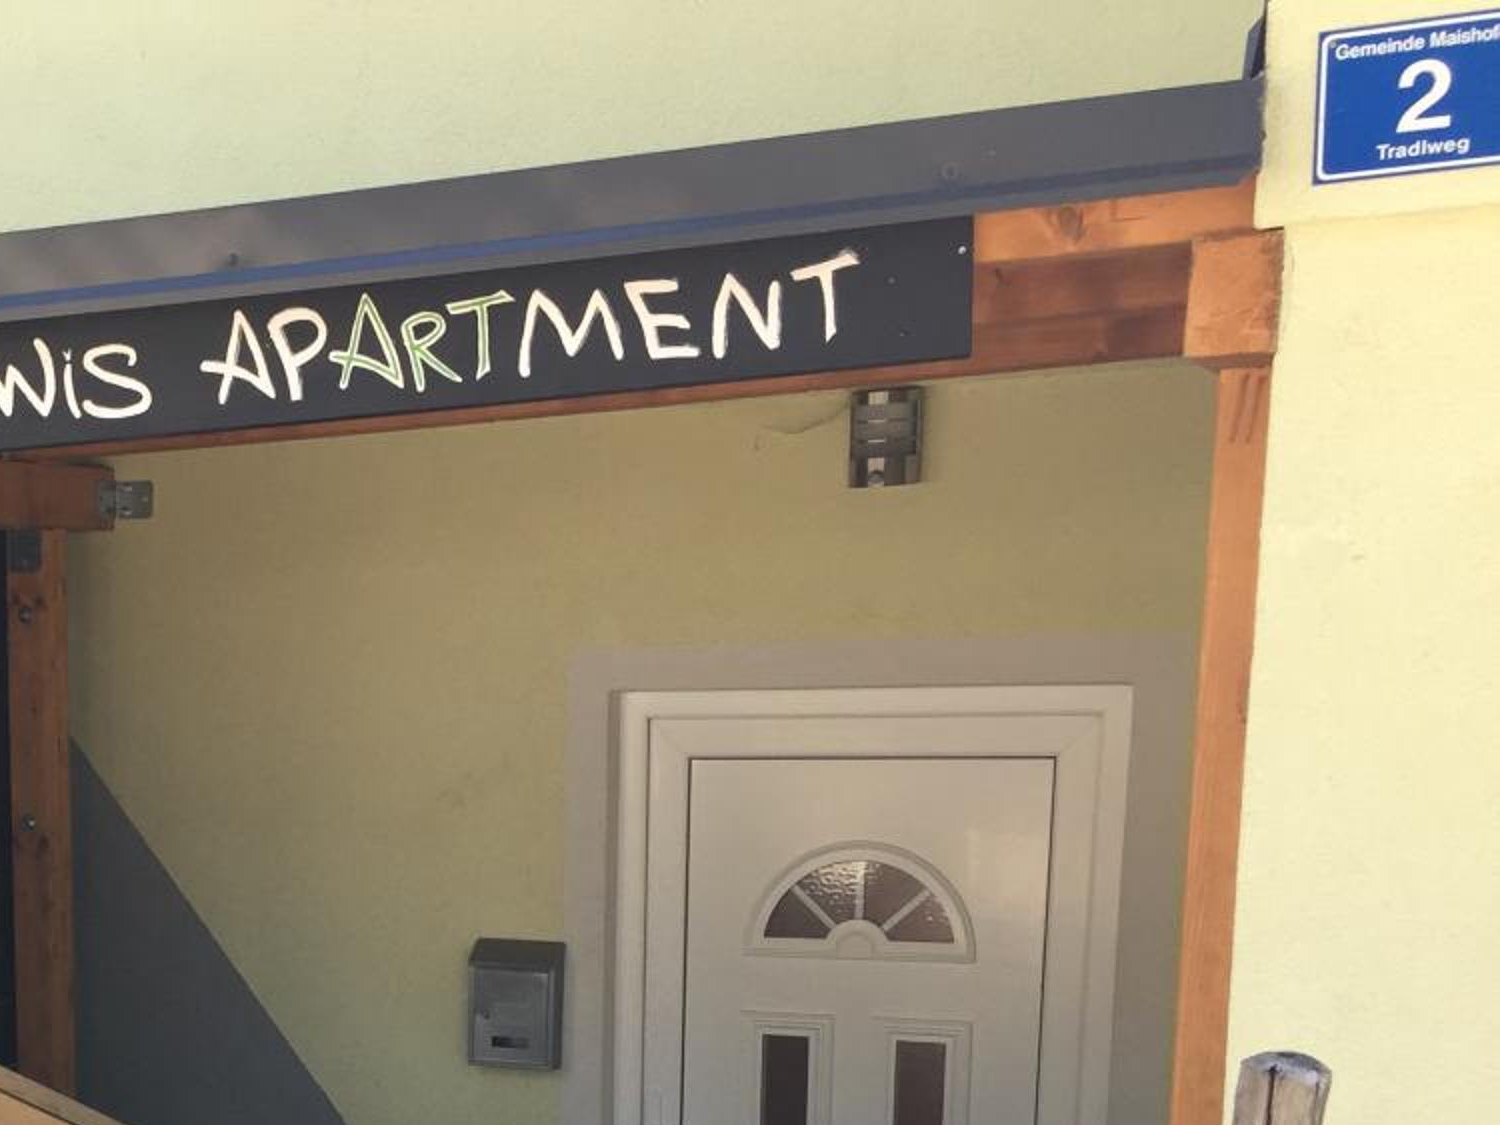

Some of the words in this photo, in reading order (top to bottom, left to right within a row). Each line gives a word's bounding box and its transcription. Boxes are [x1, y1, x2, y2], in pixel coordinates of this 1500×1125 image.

[1335, 34, 1425, 60] Gemeinde
[1396, 58, 1451, 133] 2
[1376, 137, 1470, 160] Tradlweg
[200, 249, 861, 405] APARTMENT
